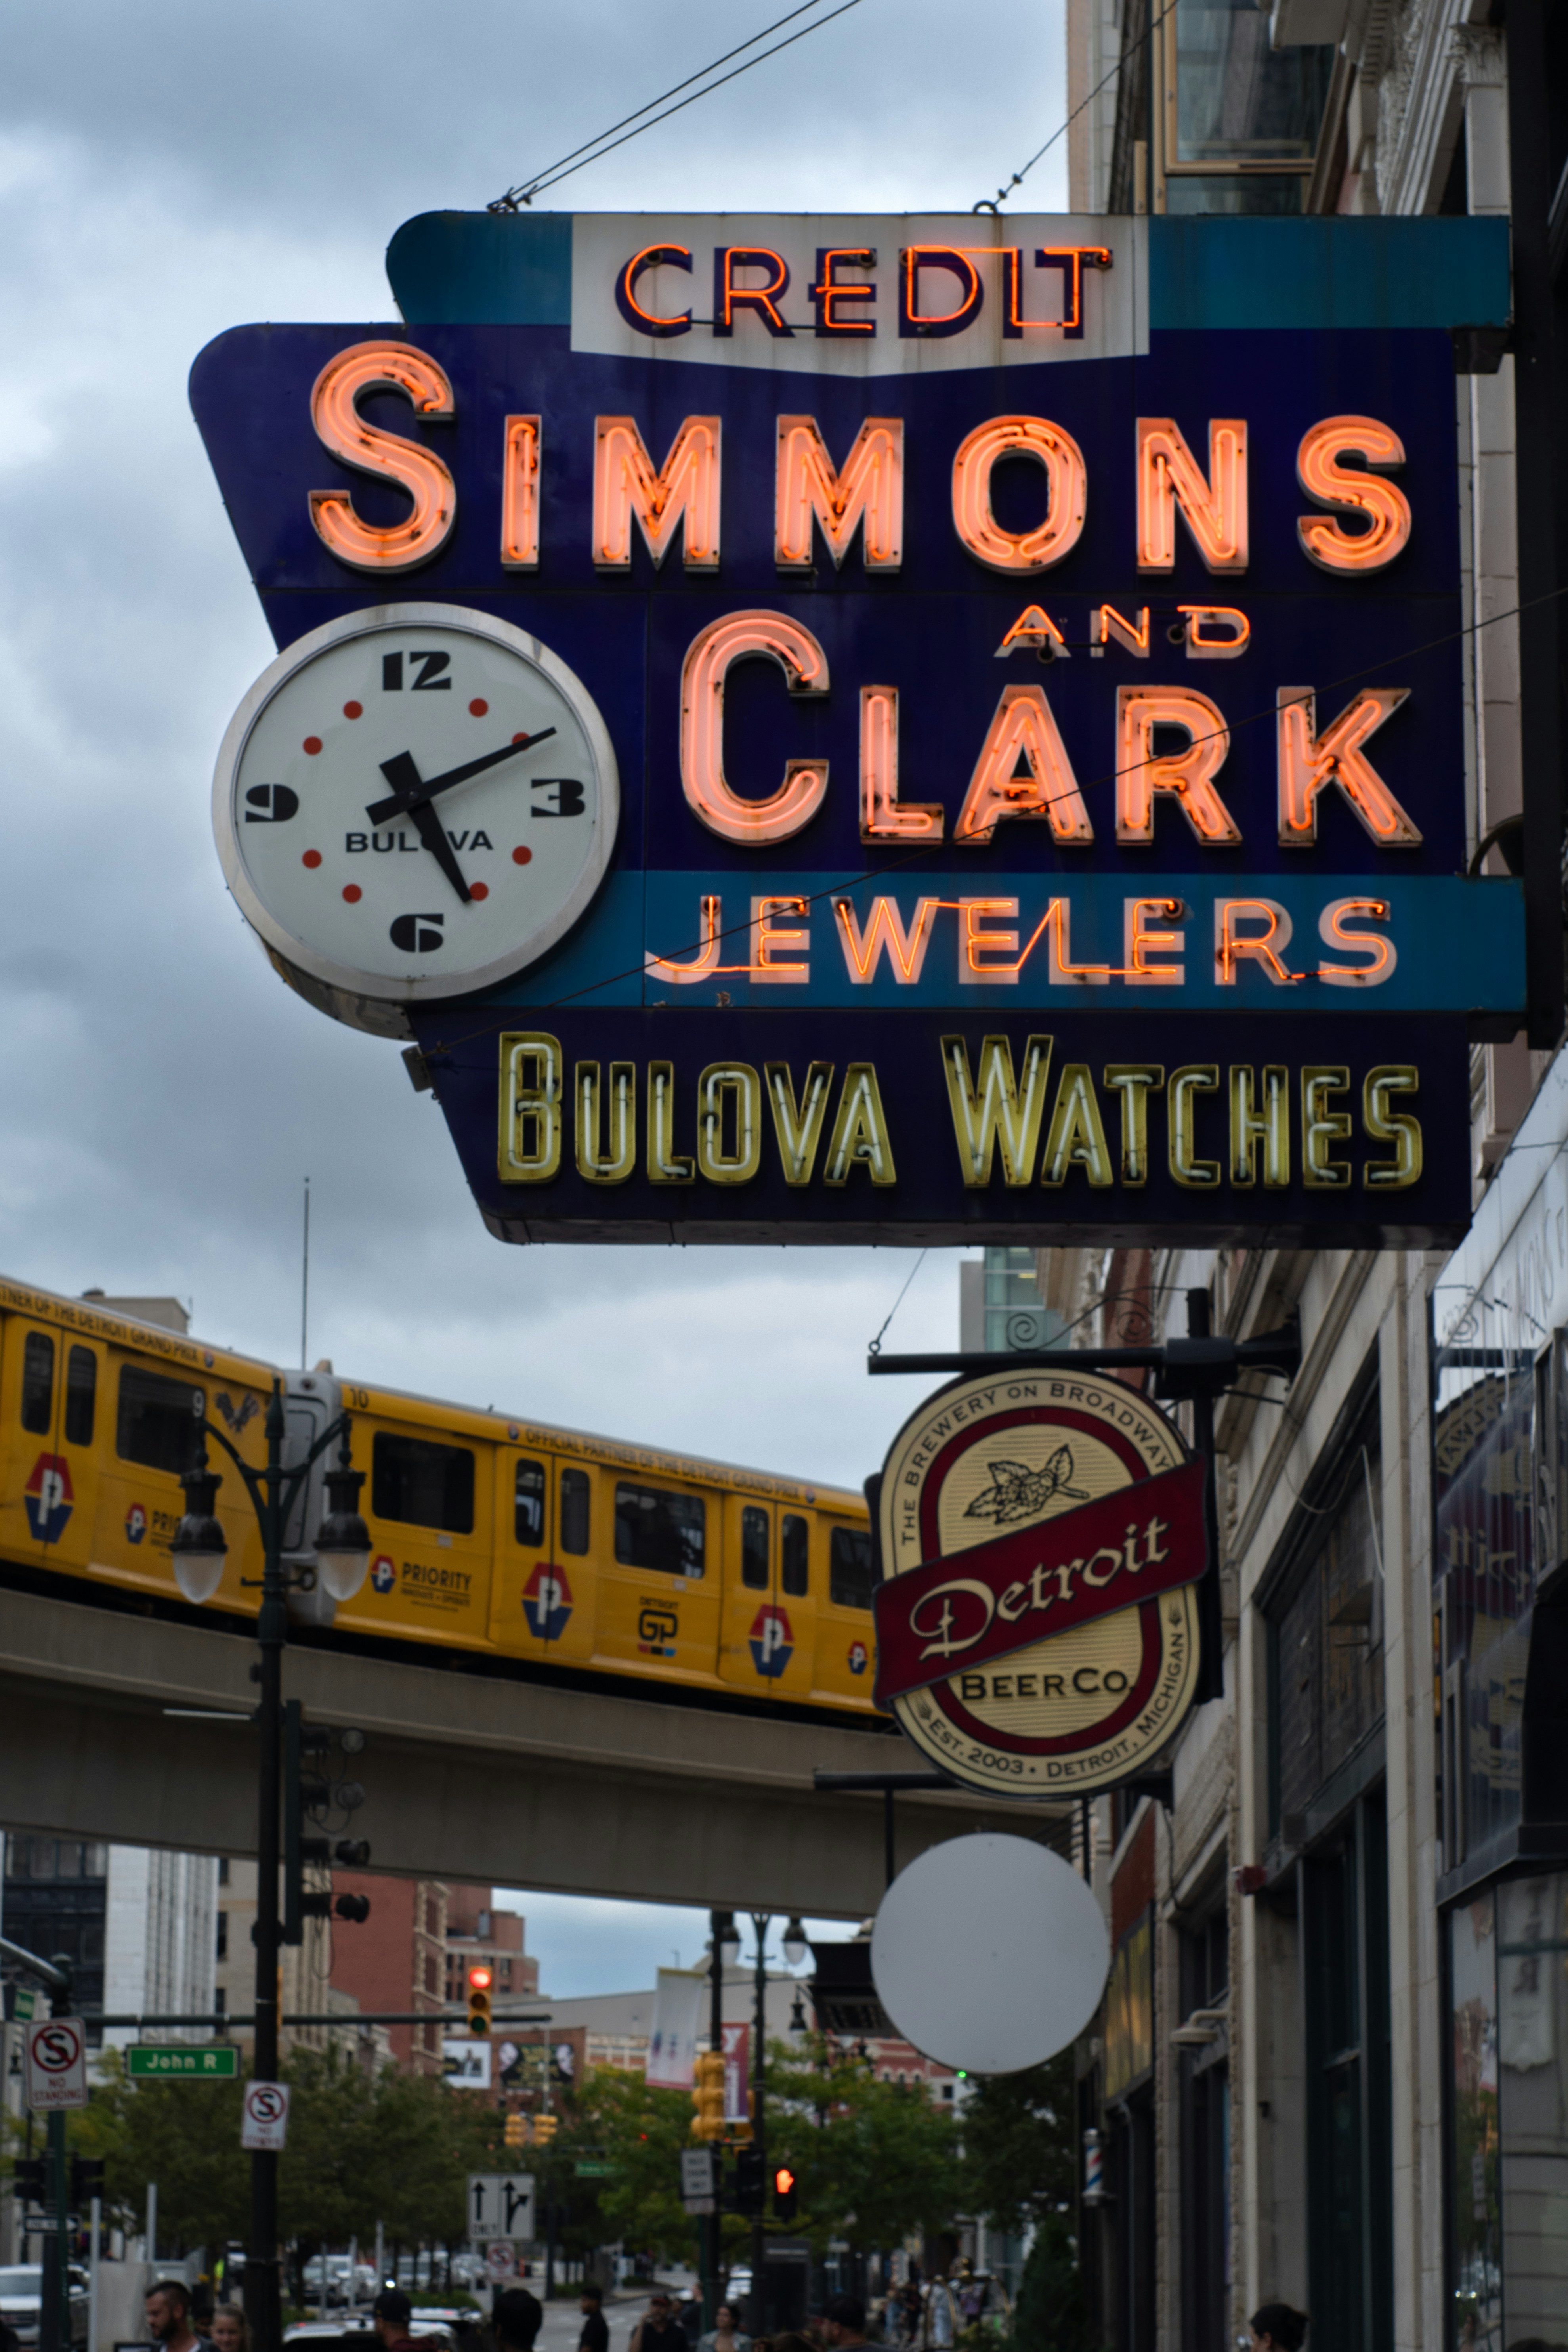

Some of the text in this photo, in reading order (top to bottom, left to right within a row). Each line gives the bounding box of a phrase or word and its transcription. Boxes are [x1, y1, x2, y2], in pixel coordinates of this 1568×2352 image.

[614, 243, 1113, 339] CREDIT
[308, 340, 1412, 577] SIMMONS
[994, 604, 1251, 659] AND
[382, 651, 451, 690] 12
[680, 609, 1423, 847] CLARK
[245, 784, 299, 823] 9
[531, 779, 585, 817] 3
[346, 831, 493, 853] BULVA
[390, 913, 444, 953] 6
[645, 897, 1397, 986] JEWELERS
[498, 1032, 1423, 1188] BULOVA WATCHES
[53, 1300, 78, 1326] THE
[79, 1309, 127, 1341] DETROIT
[130, 1326, 171, 1354] GRAND
[173, 1339, 198, 1362] PRIX
[193, 1390, 205, 1418] 9
[348, 1388, 369, 1409] 10
[901, 1383, 1170, 1546] THE BREWERY ON BROADWAY
[402, 1562, 472, 1592] PRIORITY
[910, 1516, 1172, 1661] Detroit
[639, 1609, 678, 1644] GP
[930, 1633, 1184, 1778] EST. 2003 DETROIT, MICHIGAN
[961, 1674, 1065, 1700] BEER
[146, 2053, 217, 2069] John R
[48, 2078, 66, 2088] NO
